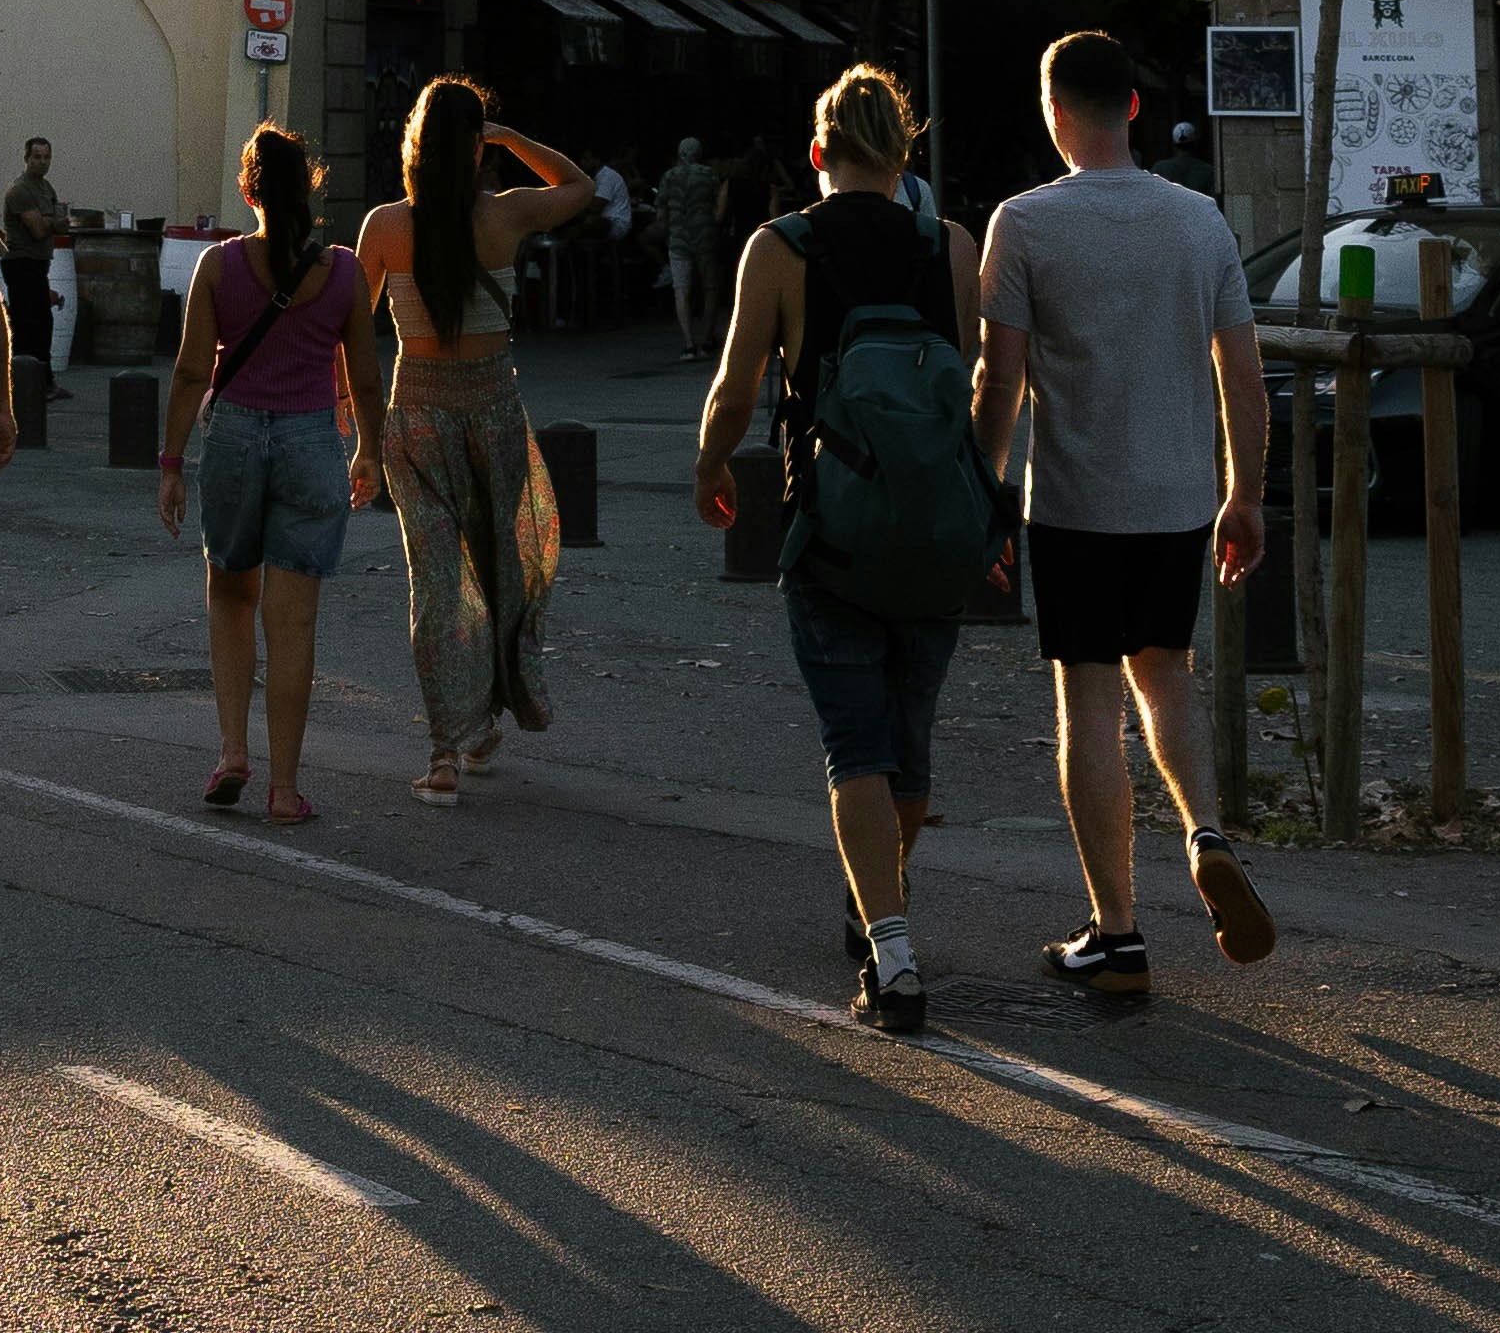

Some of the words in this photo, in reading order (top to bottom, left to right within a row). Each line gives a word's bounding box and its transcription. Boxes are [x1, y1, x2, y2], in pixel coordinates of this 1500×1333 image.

[1362, 54, 1415, 62] BARCELONA
[1372, 165, 1411, 175] TAPAS
[1394, 177, 1419, 195] TAXI
